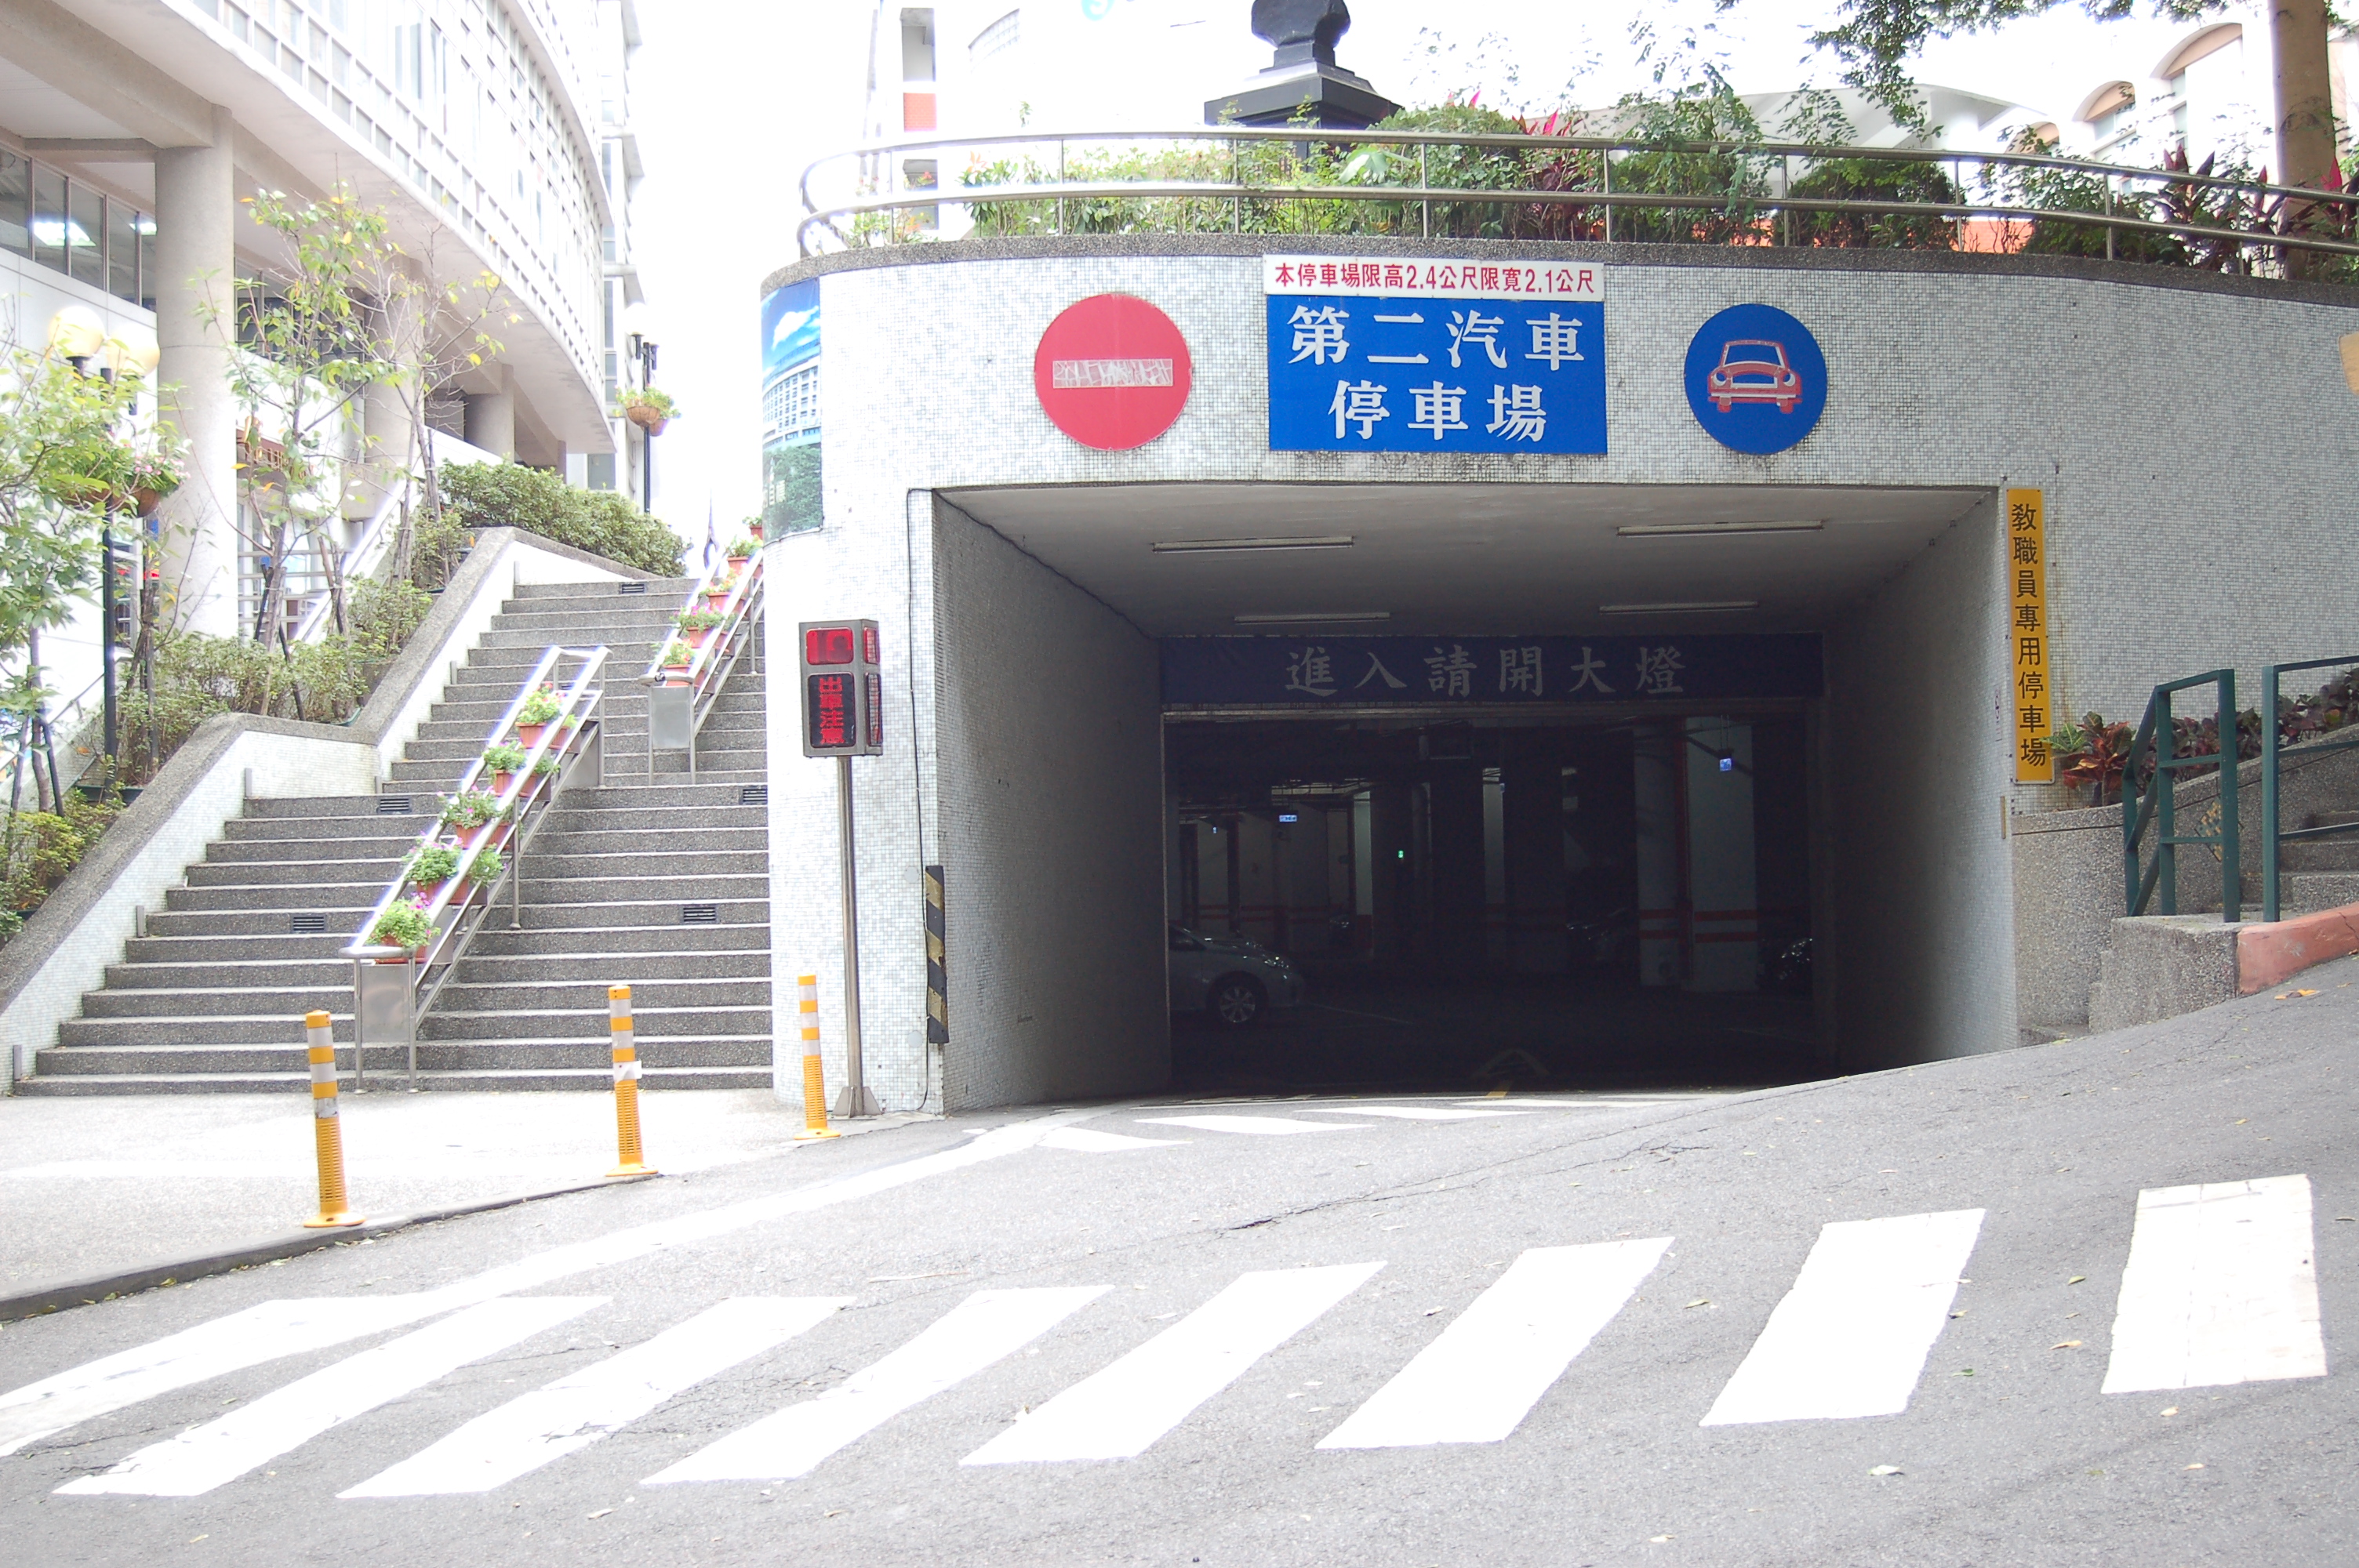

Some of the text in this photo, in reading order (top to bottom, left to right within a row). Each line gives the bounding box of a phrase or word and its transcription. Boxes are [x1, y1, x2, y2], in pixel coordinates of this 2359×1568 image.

[1275, 263, 1594, 294] 本停車場限高2.4公尺限寬2.1公尺
[1288, 305, 1584, 371] 第二汽車
[1328, 380, 1547, 441] 停車場
[1285, 644, 1687, 697] 進入請開大燈
